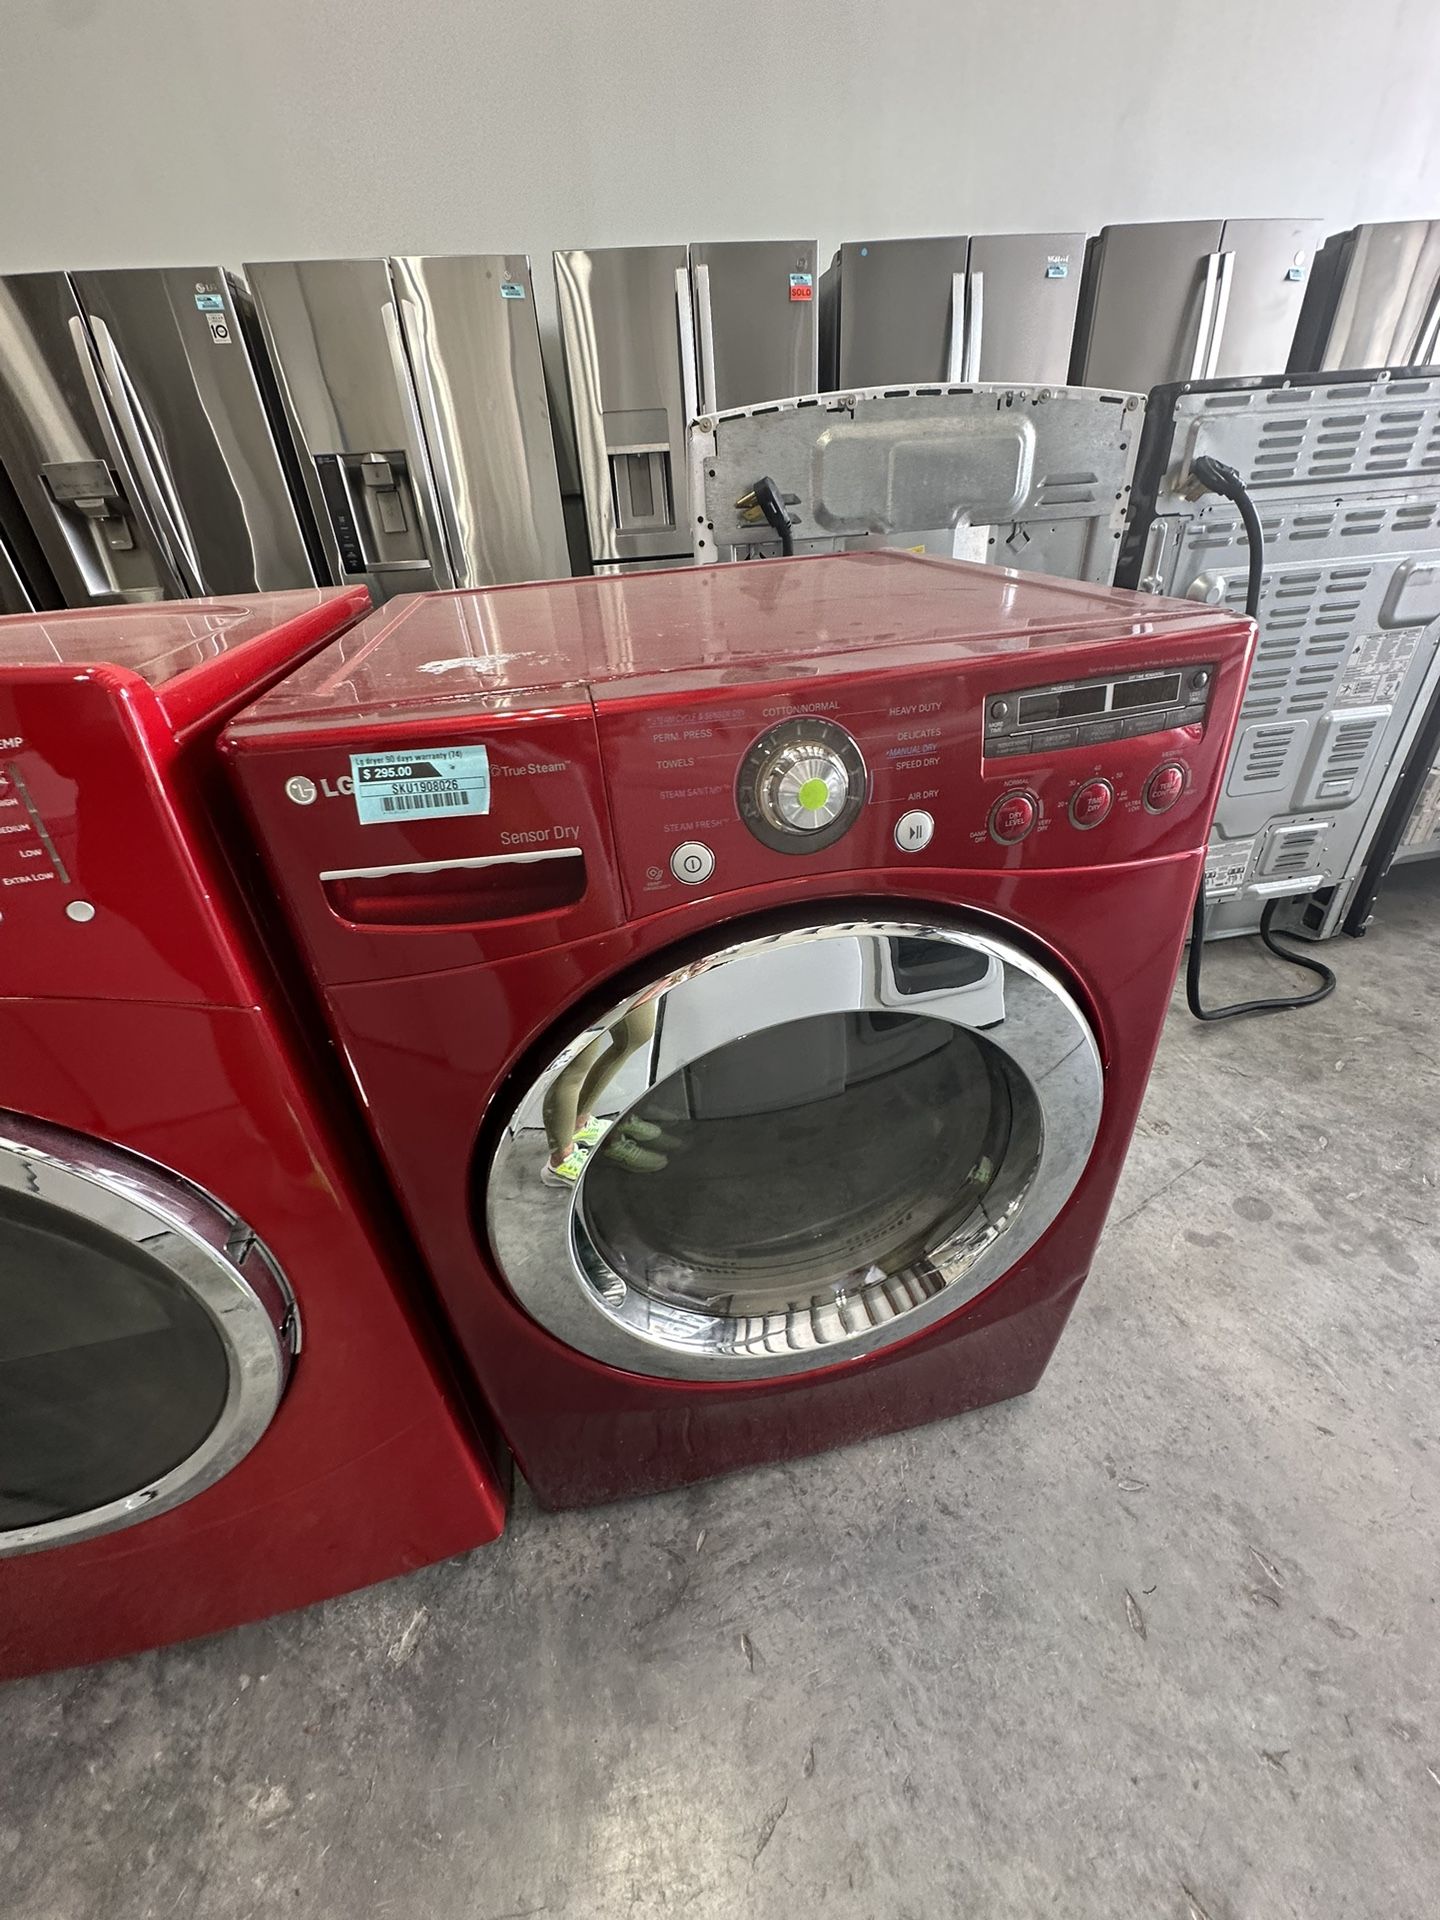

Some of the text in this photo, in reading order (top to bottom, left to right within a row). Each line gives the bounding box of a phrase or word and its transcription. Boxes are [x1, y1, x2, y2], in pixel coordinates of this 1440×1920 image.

[791, 288, 812, 297] SOLD
[889, 702, 942, 717] HEAVY DUTY
[683, 728, 713, 741] PRESS
[897, 727, 942, 741] DELICATES
[385, 754, 395, 763] 90
[397, 754, 414, 763] days
[656, 757, 695, 769] TOWELS
[896, 757, 940, 771] SPEED DRY
[363, 766, 412, 780] $ 295.00
[320, 775, 355, 798] LG
[392, 779, 459, 795] SKU1908026
[908, 788, 940, 801] AIR DRY
[1008, 811, 1023, 820] DRY
[664, 822, 694, 833] STEAM
[1005, 818, 1025, 827] LEVEL
[500, 825, 580, 845] Sensor Dry
